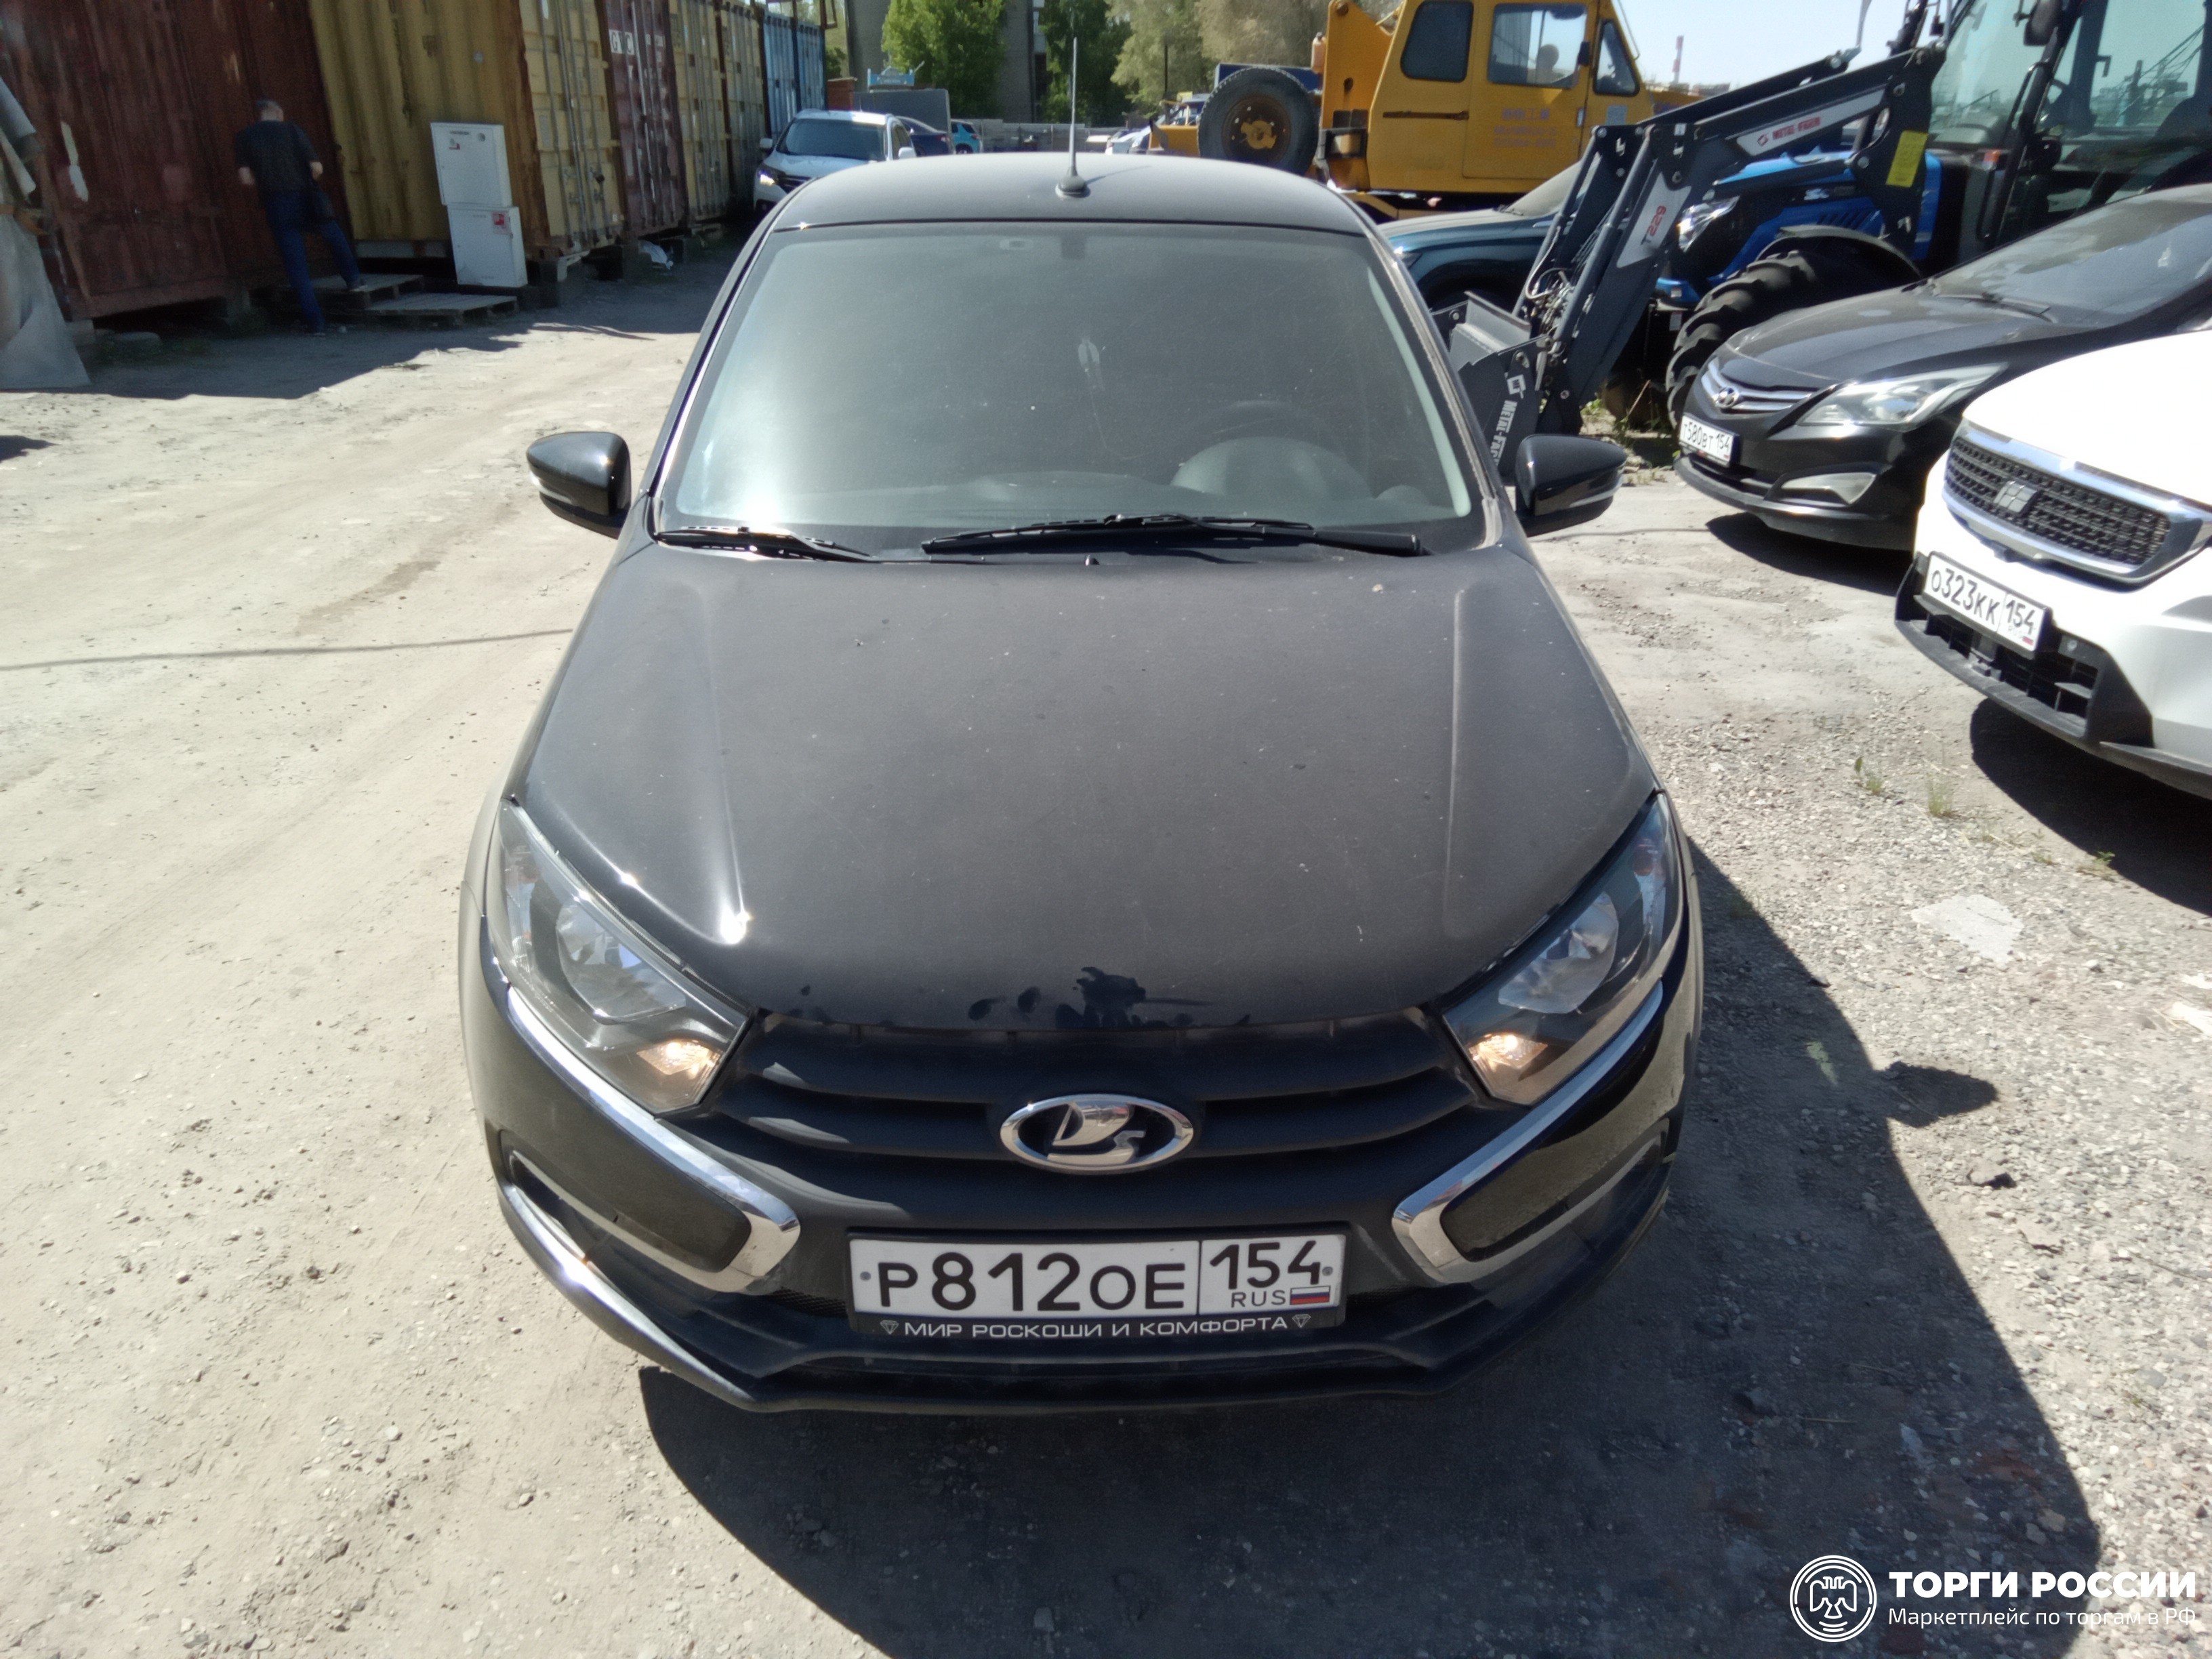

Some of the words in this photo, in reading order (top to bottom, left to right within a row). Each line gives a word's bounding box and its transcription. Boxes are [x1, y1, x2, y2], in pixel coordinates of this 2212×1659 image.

[1641, 205, 1666, 245] T229
[1716, 433, 1730, 455] 154
[1931, 568, 2001, 626] О323КК
[2006, 599, 2036, 636] 154
[878, 1252, 1185, 1311] Р812ОЕ
[1210, 1240, 1321, 1290] 154
[1231, 1289, 1286, 1308] RUS
[904, 1322, 963, 1338] МИР
[972, 1324, 1103, 1338] РОСКОШИ
[1112, 1324, 1130, 1336] И
[1140, 1316, 1288, 1336] КОМФОРТА
